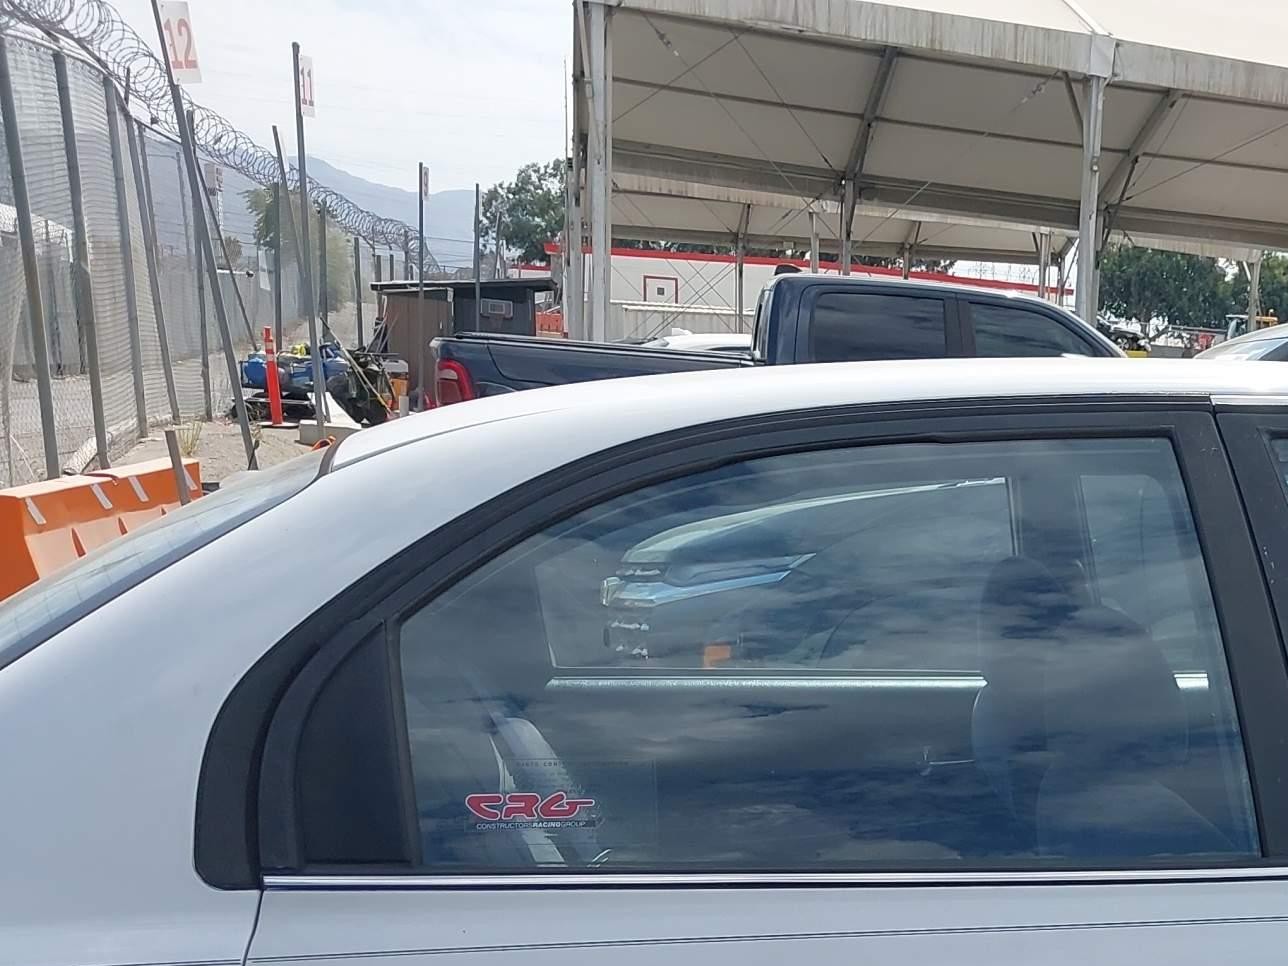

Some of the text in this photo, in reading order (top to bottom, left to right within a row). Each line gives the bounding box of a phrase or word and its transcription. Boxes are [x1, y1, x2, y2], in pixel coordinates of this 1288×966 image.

[164, 18, 197, 69] 12
[300, 66, 314, 106] 11
[465, 791, 595, 820] CRG
